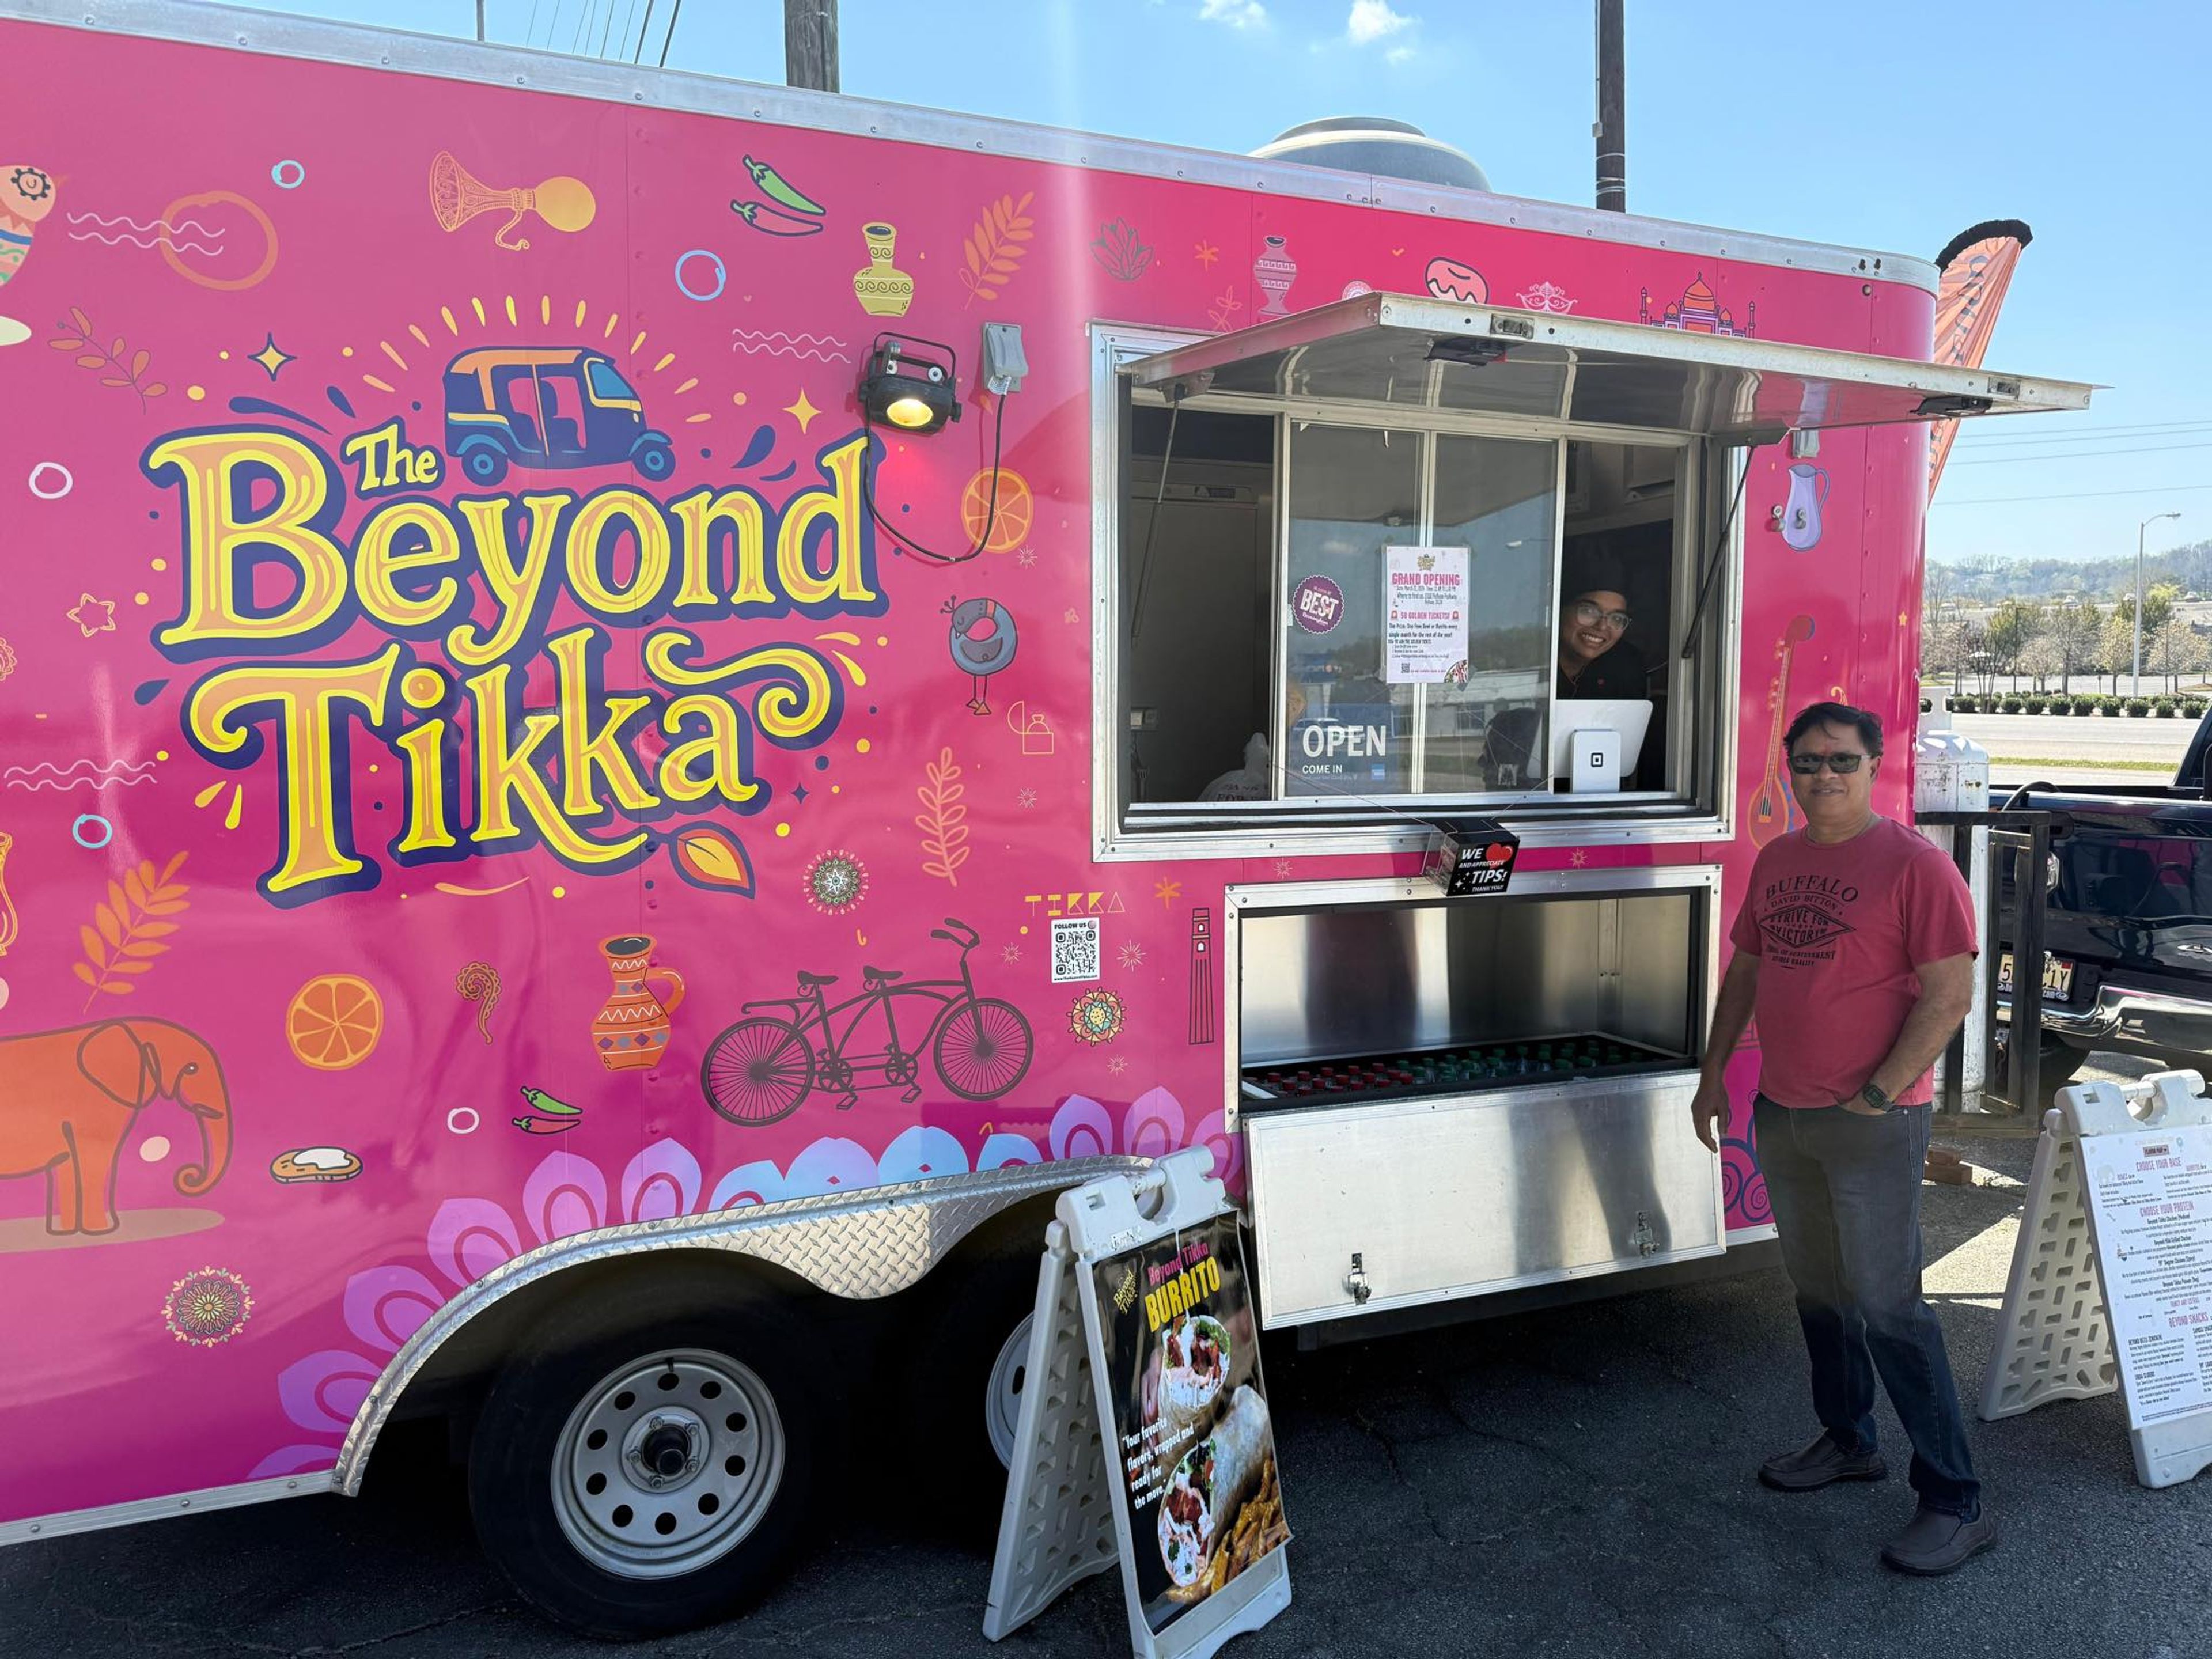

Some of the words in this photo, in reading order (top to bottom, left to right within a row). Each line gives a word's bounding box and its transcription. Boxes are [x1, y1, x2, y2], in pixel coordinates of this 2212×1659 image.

[345, 424, 439, 492] The
[148, 432, 877, 665] Beyond
[1392, 573, 1421, 585] GRAND
[1424, 574, 1460, 586] OPENING
[1300, 589, 1339, 620] BEST
[1302, 725, 1387, 757] OPEN
[189, 627, 834, 894] Tikka
[1302, 764, 1331, 774] COME
[1332, 764, 1343, 774] IN
[1462, 847, 1484, 859] WE
[1472, 869, 1508, 884] TIPS!
[1766, 874, 1859, 902] BUFFALO
[1771, 895, 1800, 907] DAVID
[1804, 895, 1836, 910] BITTON
[1769, 908, 1809, 923] STRIVE
[2156, 1158, 2169, 1170] YOUR
[2140, 1205, 2160, 1217] CHOOSE
[1146, 1254, 1183, 1286] Beyond
[1183, 1242, 1210, 1266] Tikka
[1145, 1256, 1221, 1332] BURRITO
[1142, 1417, 1168, 1440] favorite
[1127, 1450, 1153, 1472] flavors,
[1154, 1429, 1180, 1456] wrapped
[1181, 1421, 1195, 1440] and
[1131, 1471, 1150, 1493] ready
[1152, 1465, 1162, 1480] for
[1134, 1495, 1146, 1510] the
